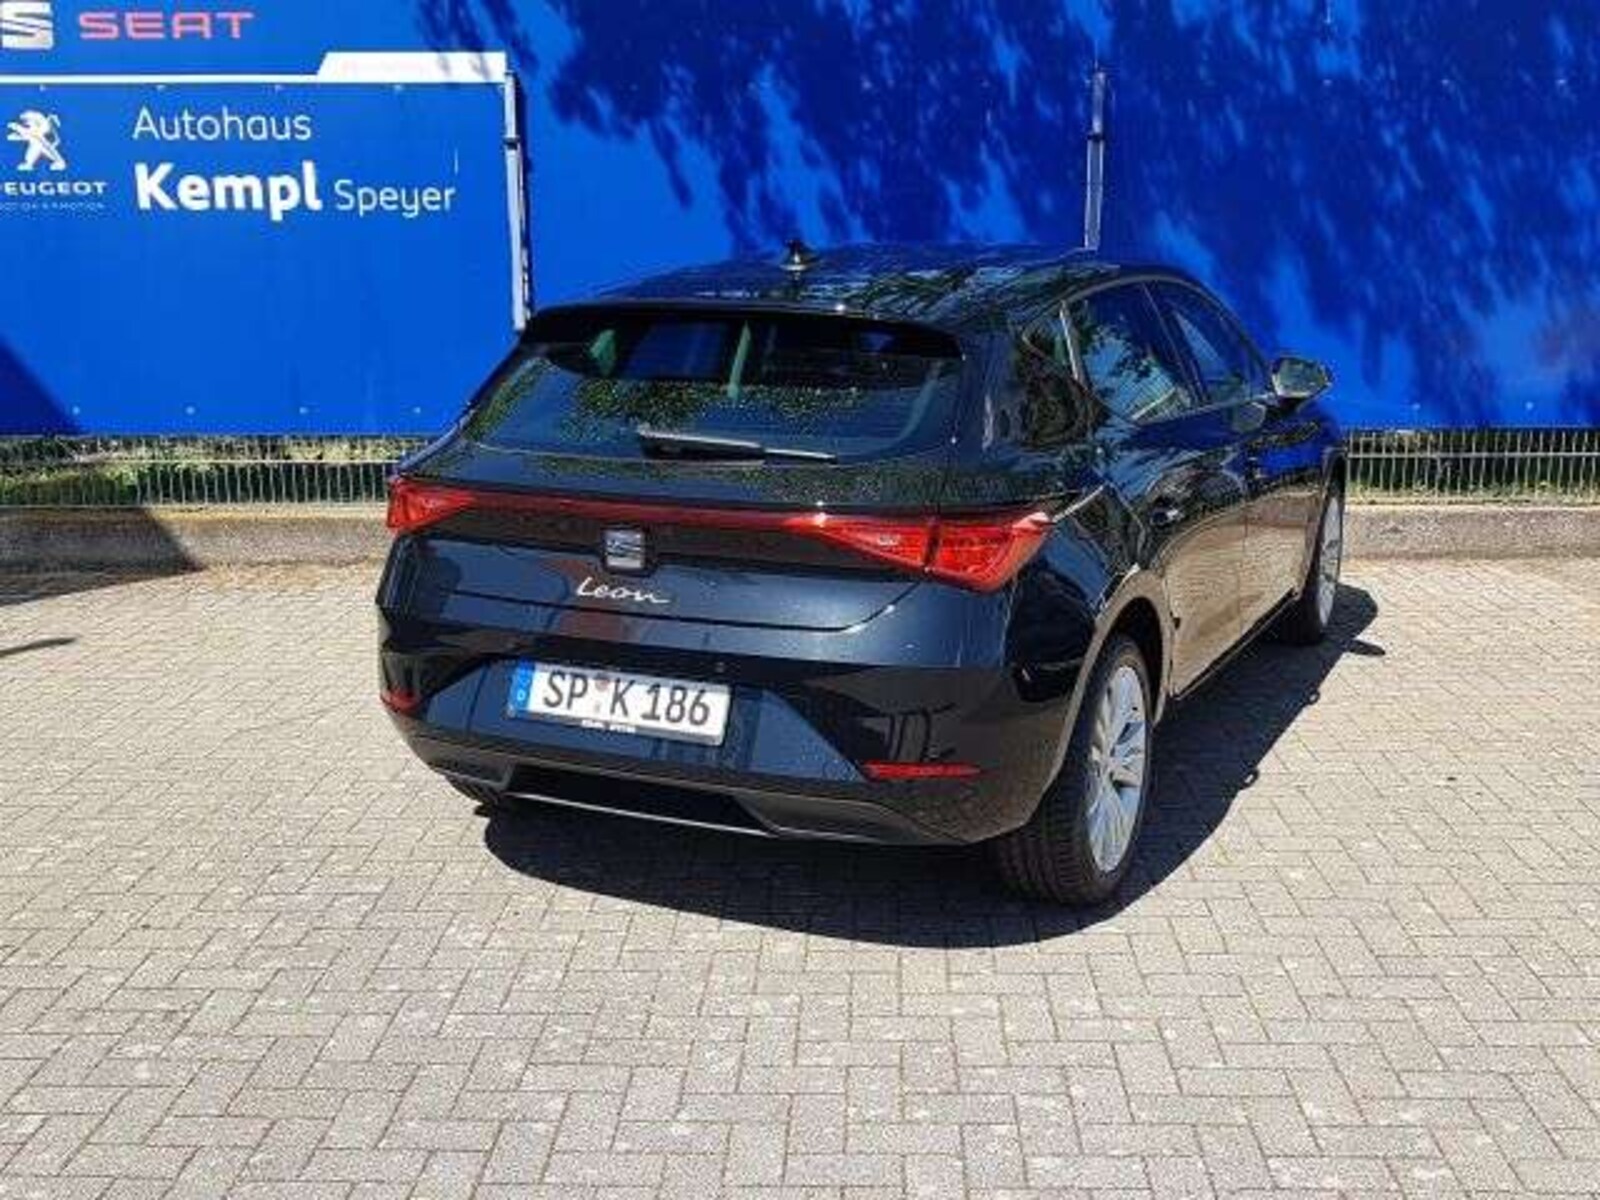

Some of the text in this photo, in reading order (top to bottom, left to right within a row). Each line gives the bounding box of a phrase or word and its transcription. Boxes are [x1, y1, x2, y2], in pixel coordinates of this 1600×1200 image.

[79, 12, 254, 39] SEAT
[133, 108, 312, 141] Autohaus
[0, 181, 107, 196] EUGEOT
[135, 161, 456, 220] Kempl Speyer
[577, 576, 669, 603] Leon
[544, 671, 588, 710] SP
[611, 678, 636, 717] K
[641, 683, 711, 727] 186
